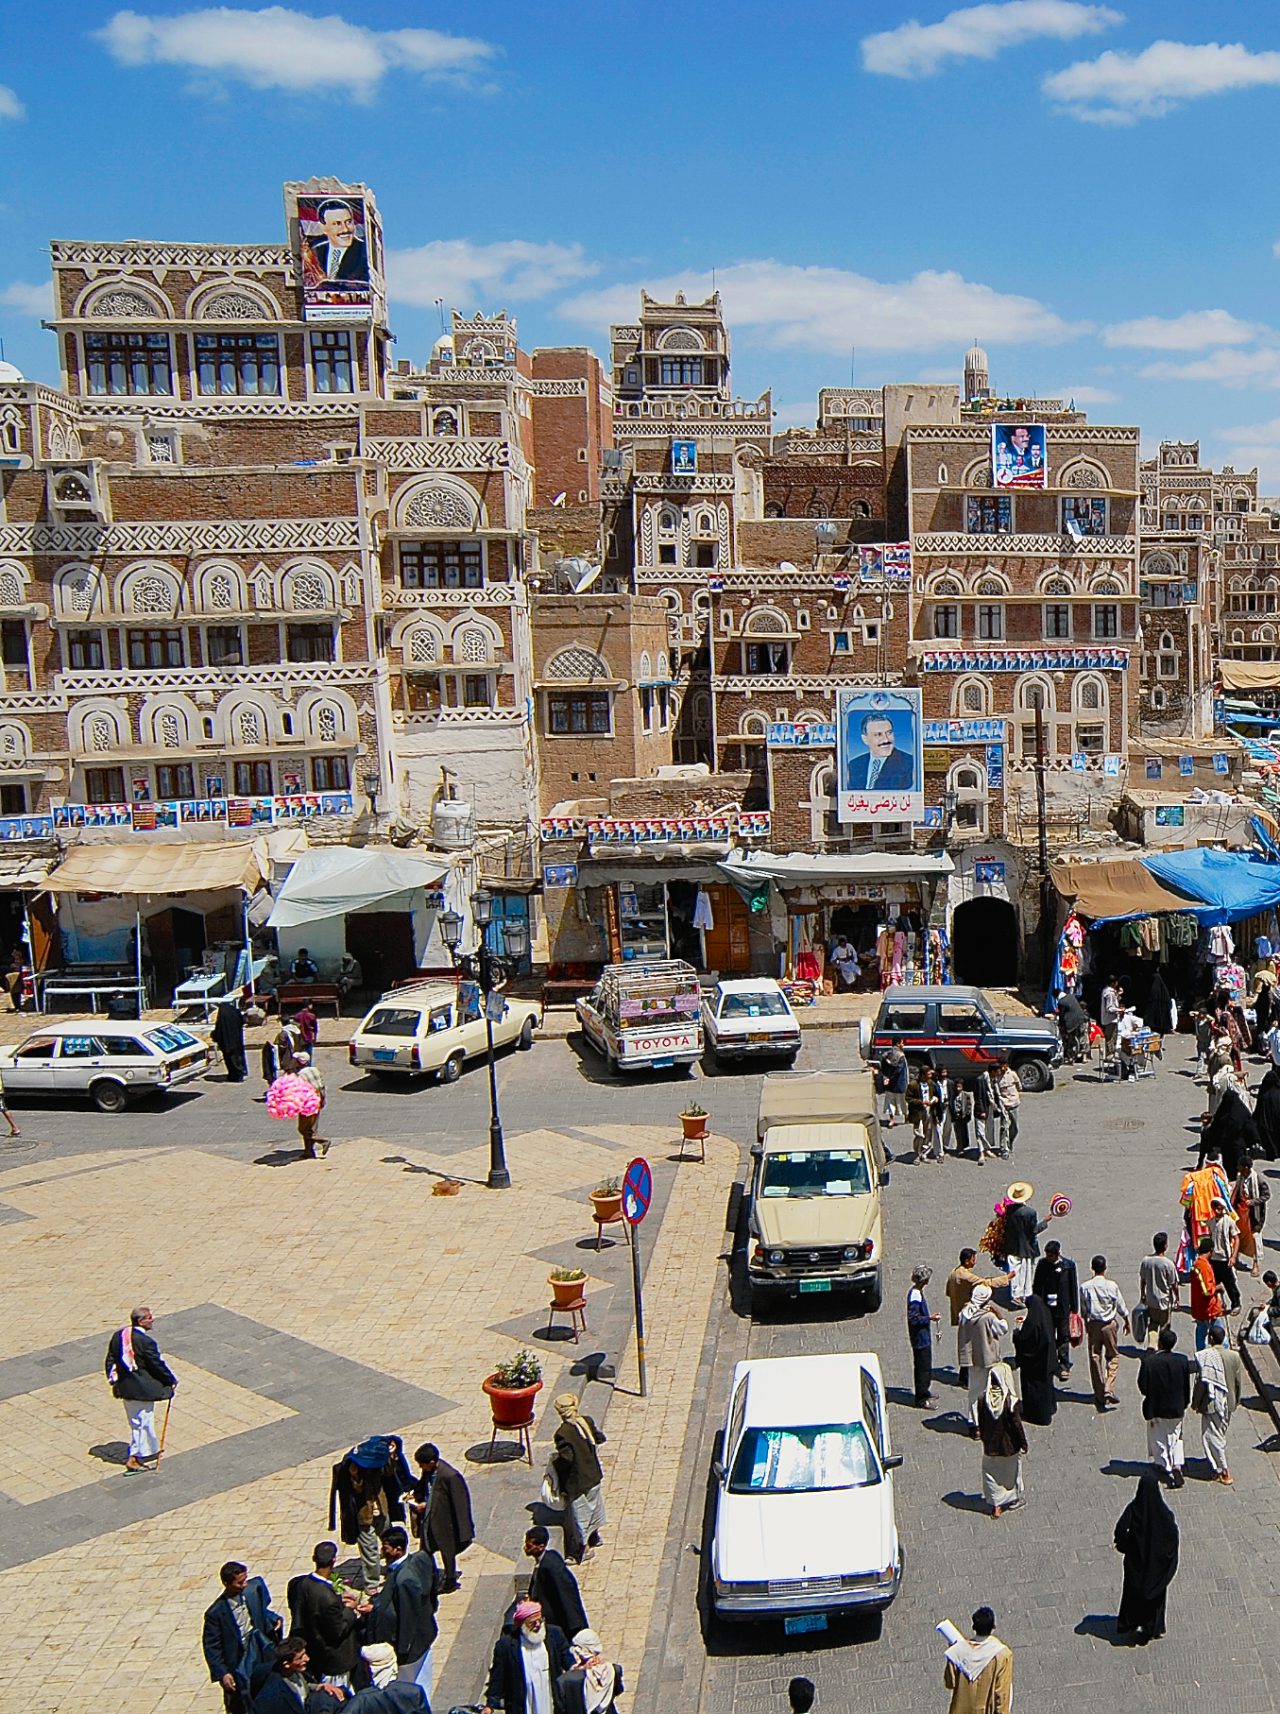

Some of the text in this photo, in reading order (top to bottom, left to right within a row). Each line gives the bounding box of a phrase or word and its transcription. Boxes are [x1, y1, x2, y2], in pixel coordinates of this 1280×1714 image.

[848, 794, 911, 814] لن نرضى بغيرك
[633, 1036, 689, 1050] TOYOTA
